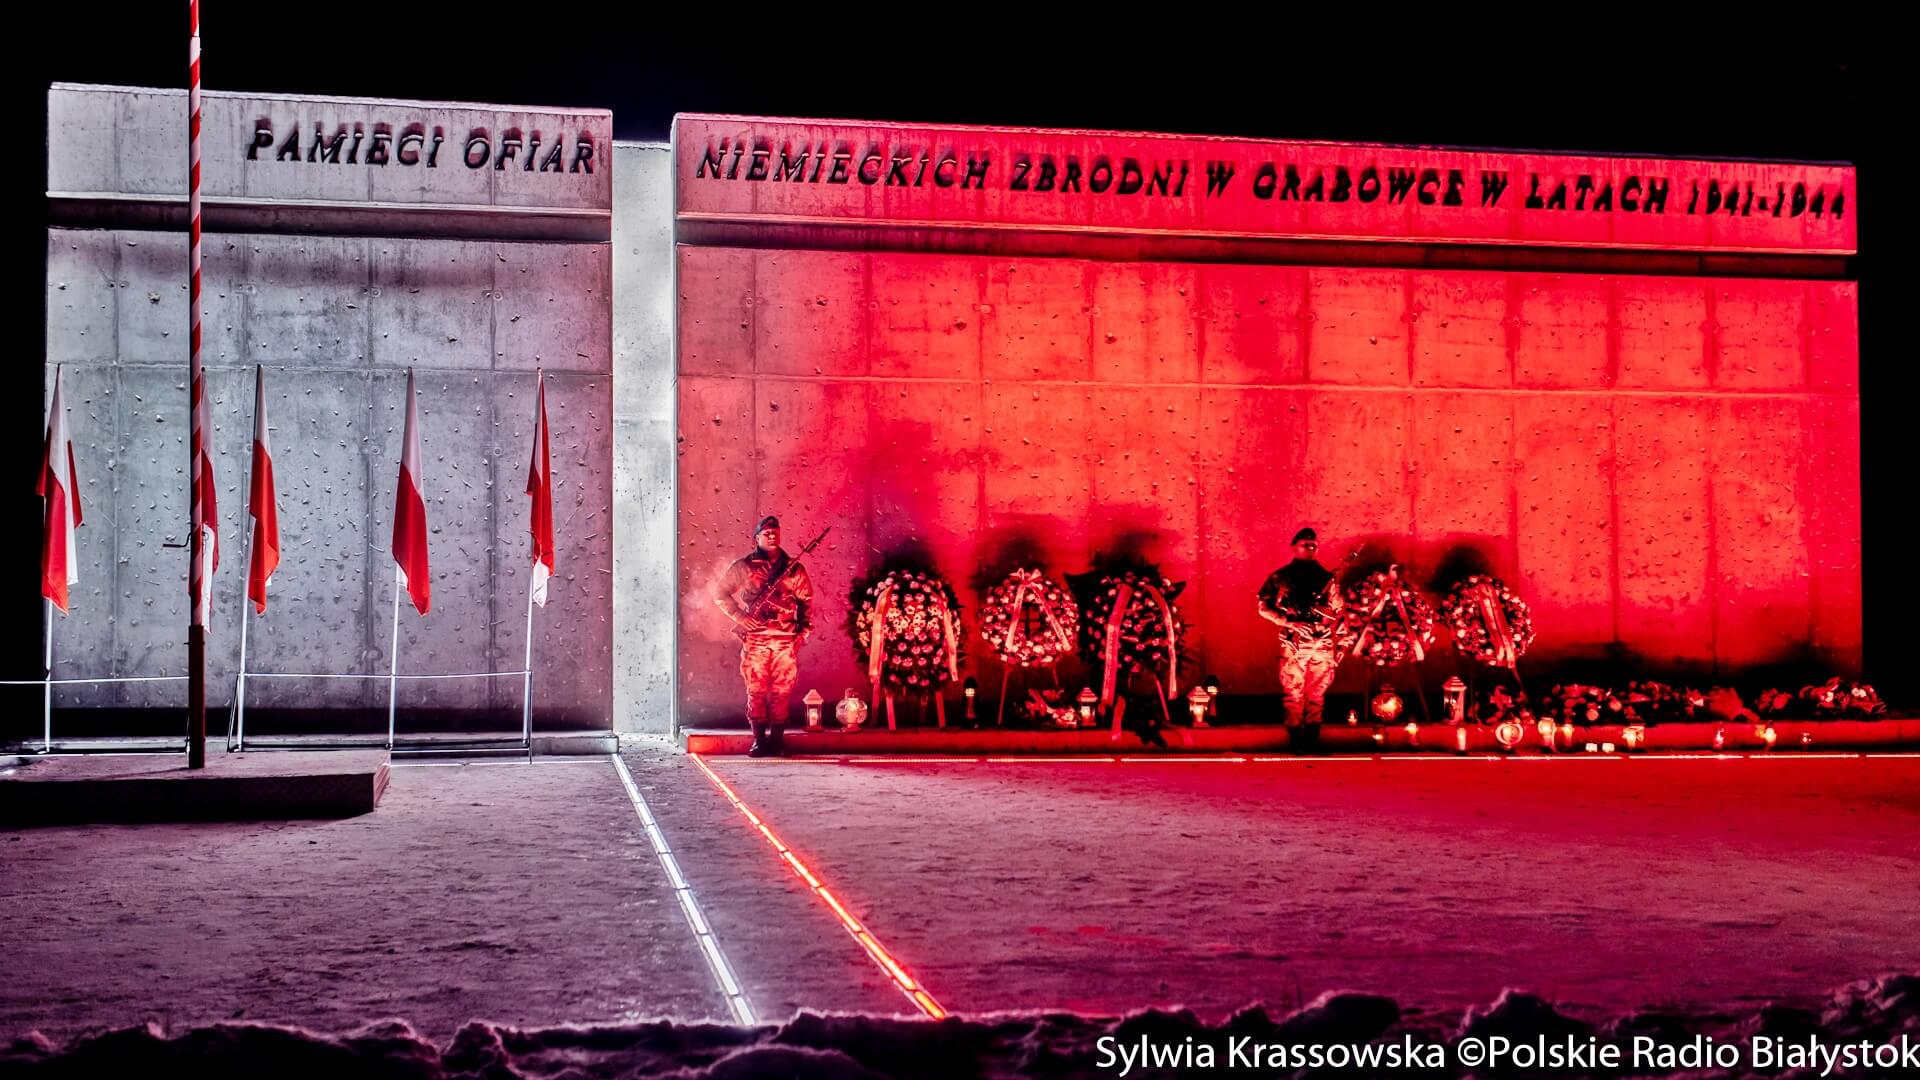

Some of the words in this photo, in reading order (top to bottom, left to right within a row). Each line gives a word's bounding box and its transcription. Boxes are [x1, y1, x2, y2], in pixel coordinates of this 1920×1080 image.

[463, 135, 596, 174] OFIAR
[696, 148, 991, 190] NIEMIECKICH
[1009, 160, 1188, 197] ZBRODNI
[1206, 164, 1235, 199] W
[1252, 166, 1465, 207] GRABOWCE
[1481, 171, 1508, 208] W
[1525, 175, 1669, 215] LATACH
[1687, 180, 1846, 219] 1941-1944
